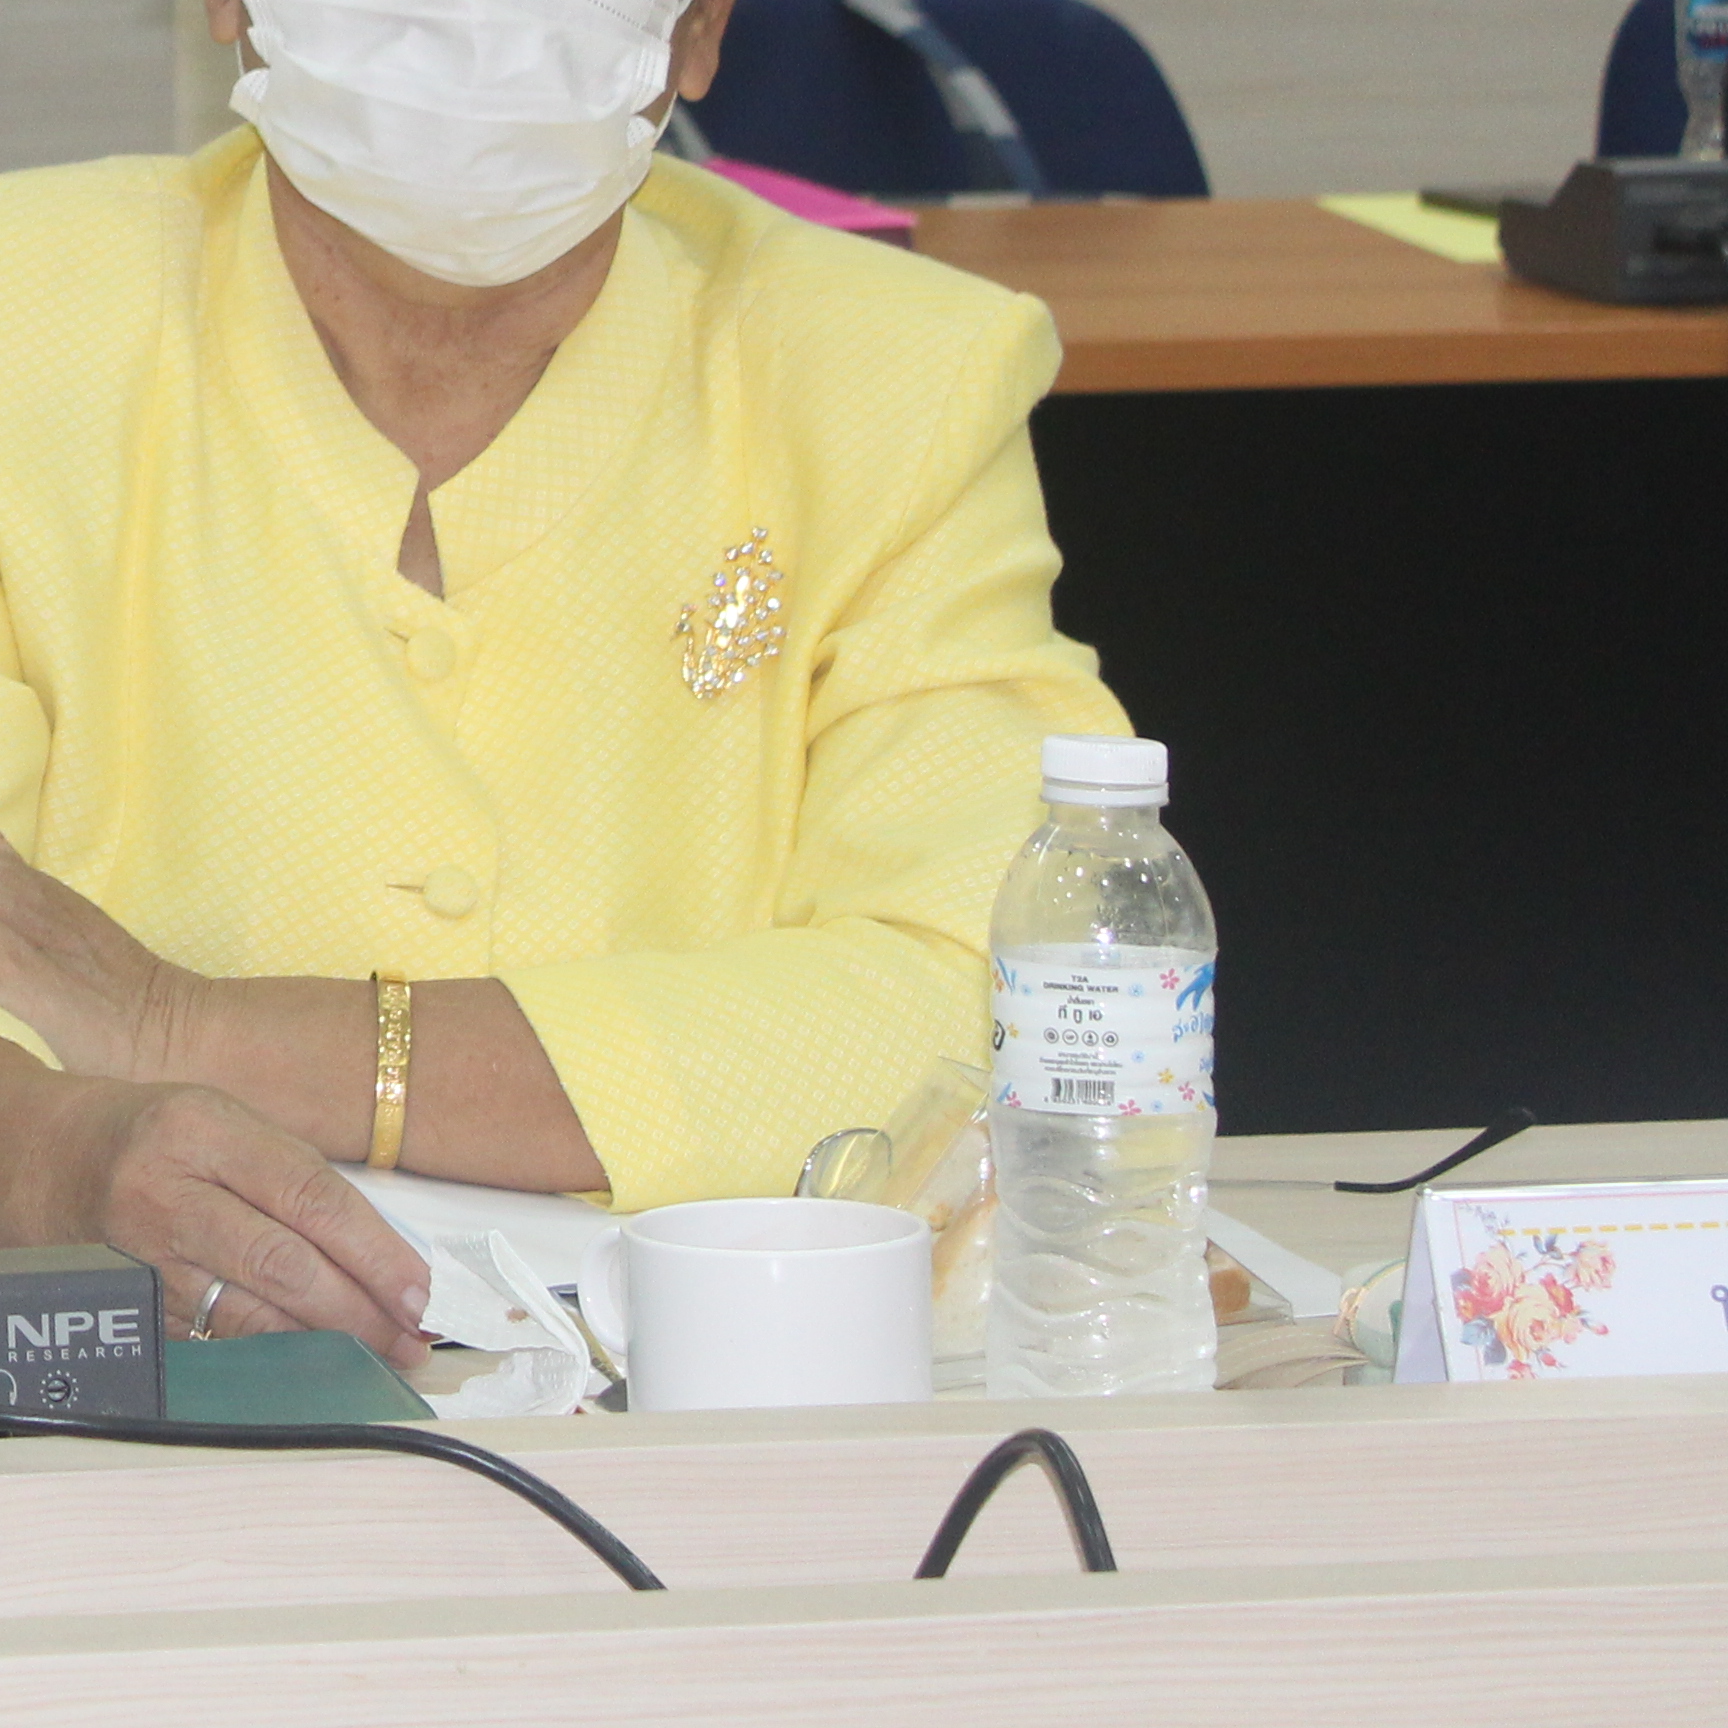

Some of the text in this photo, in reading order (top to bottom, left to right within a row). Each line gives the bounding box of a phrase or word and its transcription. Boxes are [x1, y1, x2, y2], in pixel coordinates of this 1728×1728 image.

[1043, 981, 1119, 993] DRINKING WATER
[7, 1309, 141, 1349] NPE
[8, 1345, 142, 1362] RESEARCH
